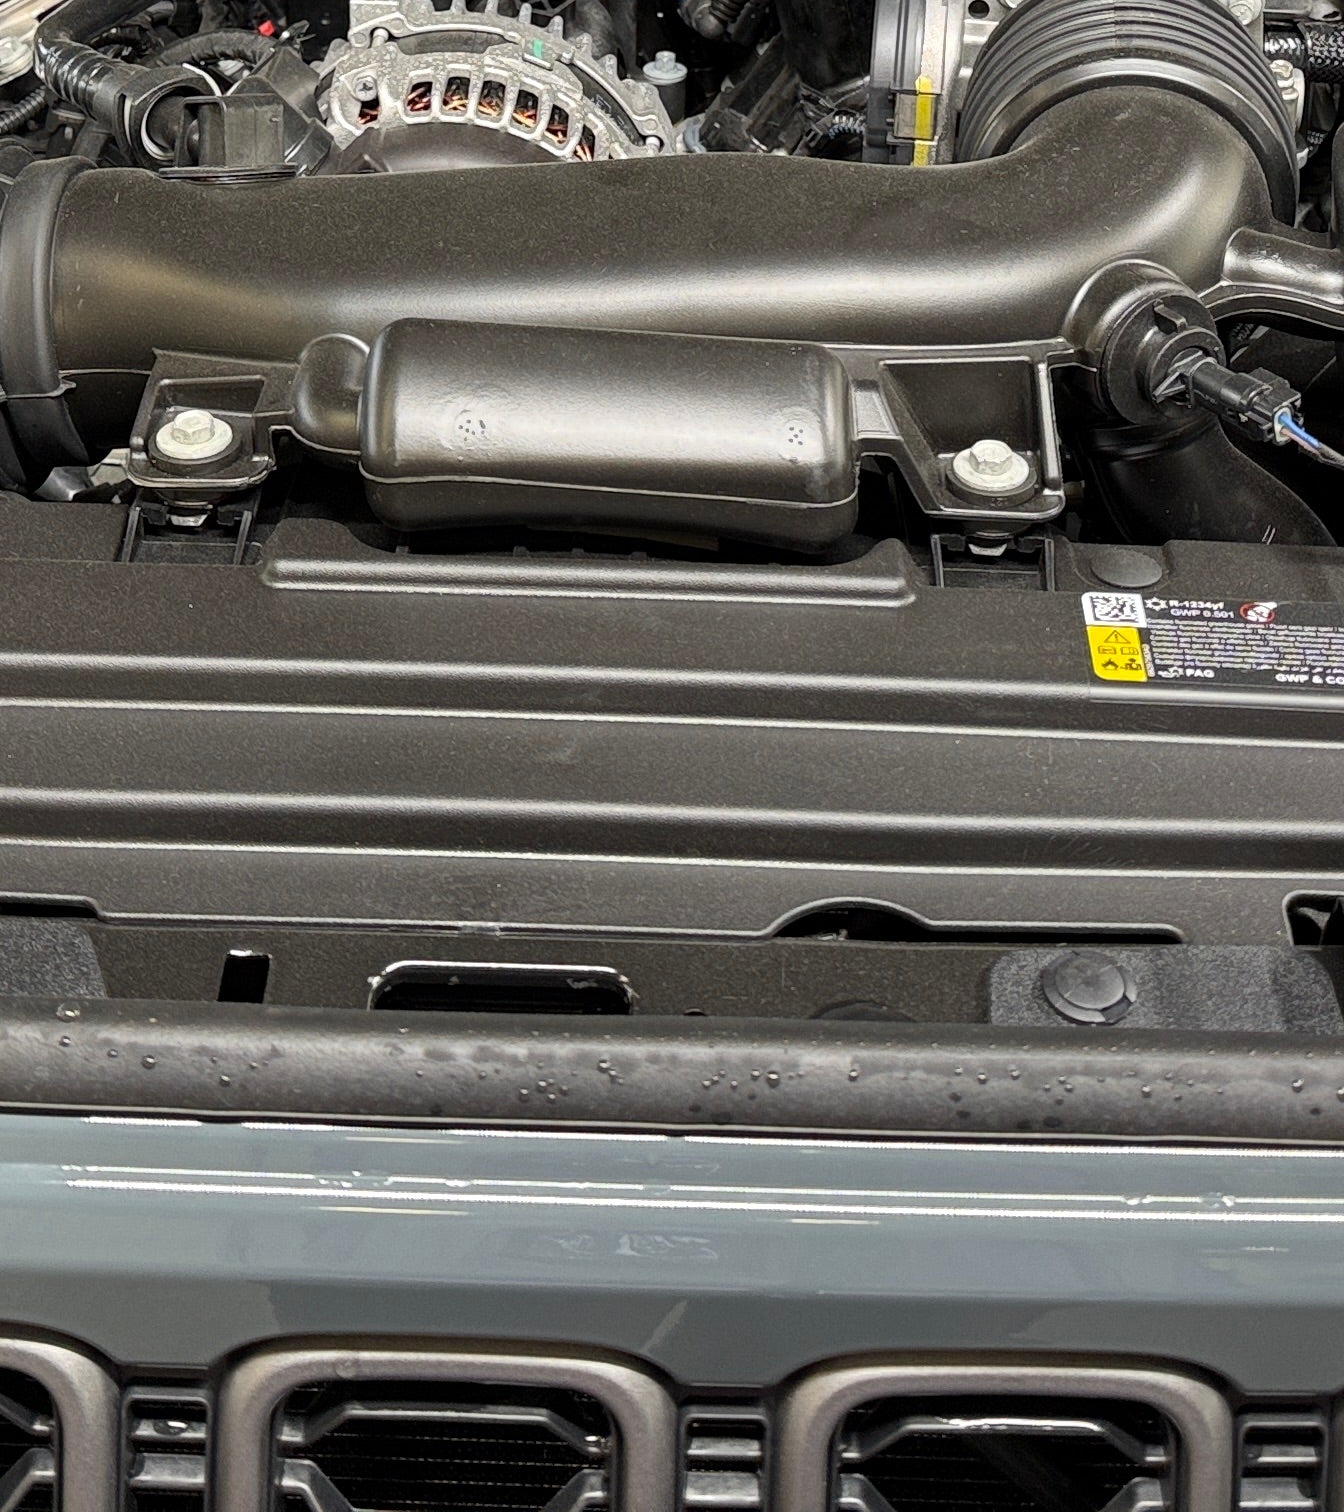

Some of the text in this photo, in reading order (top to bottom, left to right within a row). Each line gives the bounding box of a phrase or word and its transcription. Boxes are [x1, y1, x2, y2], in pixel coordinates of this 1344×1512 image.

[1168, 600, 1225, 610] R-1234yf
[1170, 609, 1235, 619] GWP 0.501
[1185, 668, 1215, 679] PAG
[1274, 673, 1309, 683] GWP
[1311, 674, 1324, 684] &
